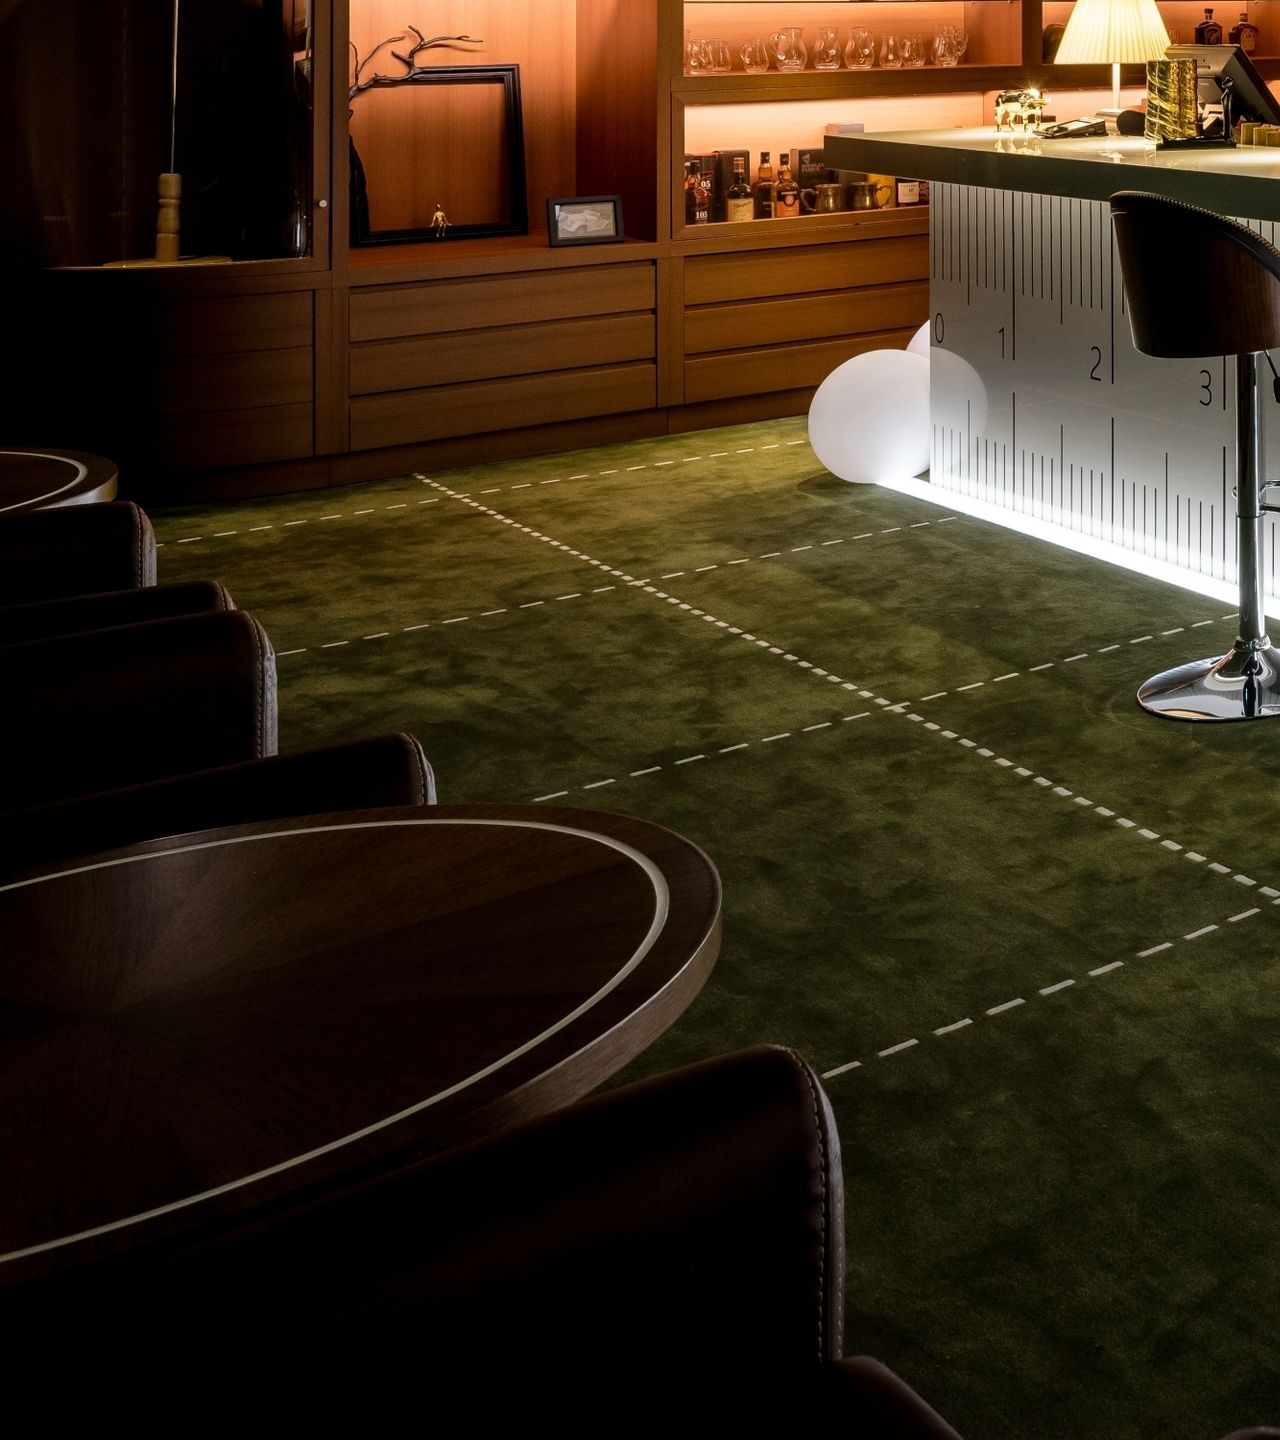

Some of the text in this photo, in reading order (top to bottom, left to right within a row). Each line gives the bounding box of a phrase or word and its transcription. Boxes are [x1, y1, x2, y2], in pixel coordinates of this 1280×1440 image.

[934, 312, 945, 344] 0
[998, 326, 1005, 359] 1
[1090, 345, 1102, 382] 2
[1199, 369, 1212, 407] 3
